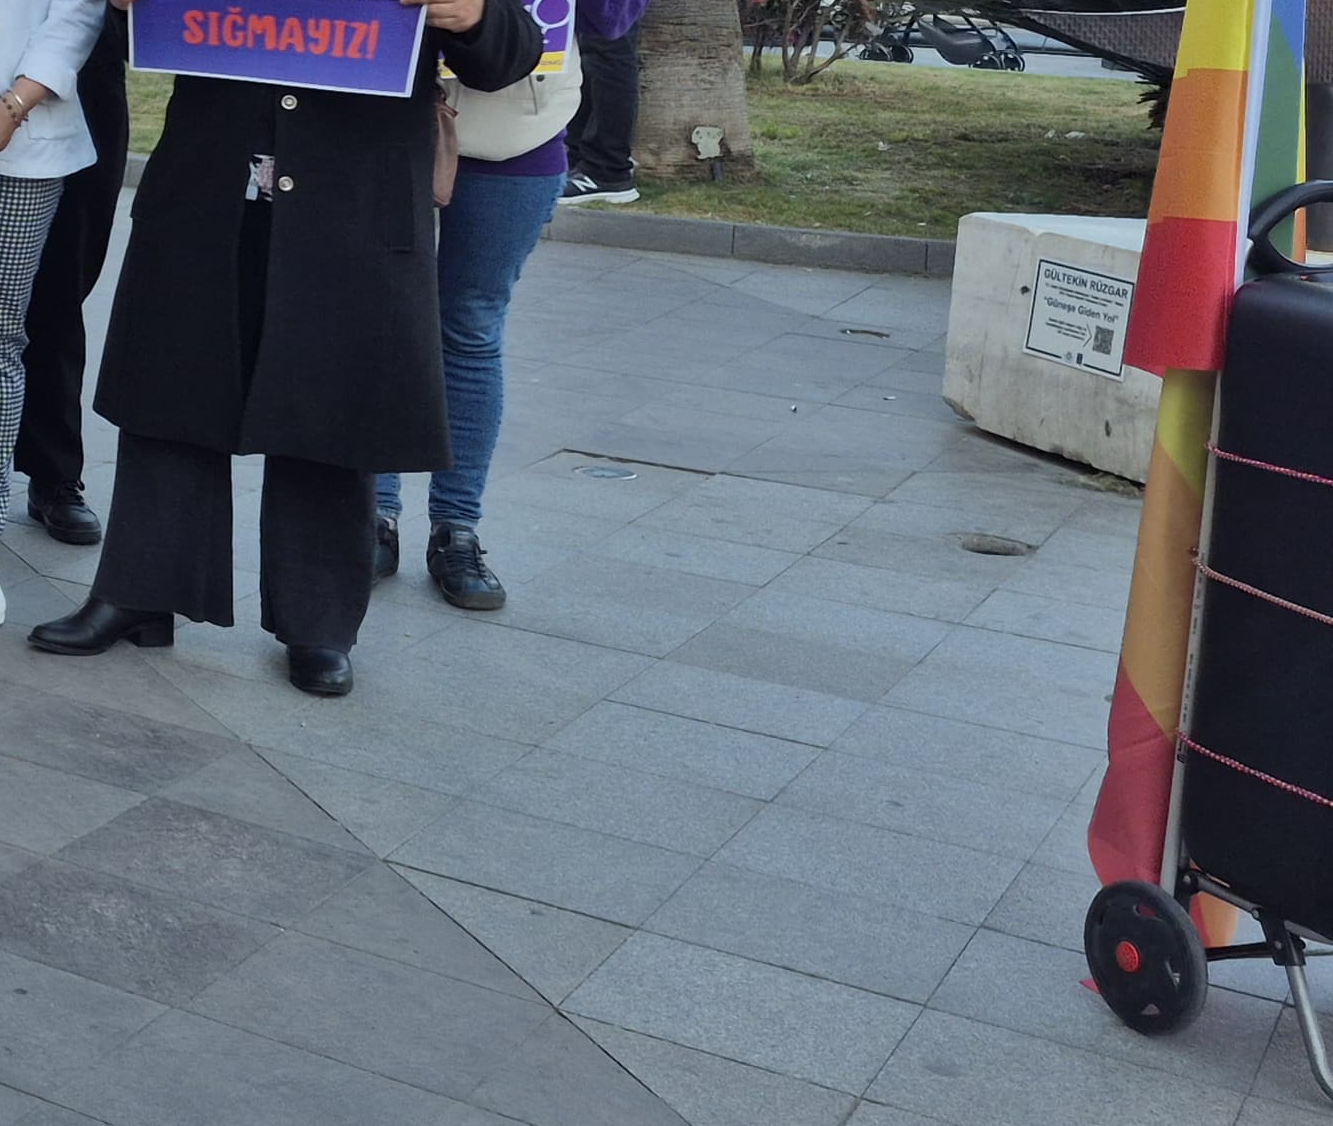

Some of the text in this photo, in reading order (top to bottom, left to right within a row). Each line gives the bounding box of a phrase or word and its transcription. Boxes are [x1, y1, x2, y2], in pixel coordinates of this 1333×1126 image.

[182, 6, 381, 61] SIĞMAYIZ!
[1043, 268, 1088, 289] GÜLTEKİN
[1089, 279, 1129, 300] RÜZGAR
